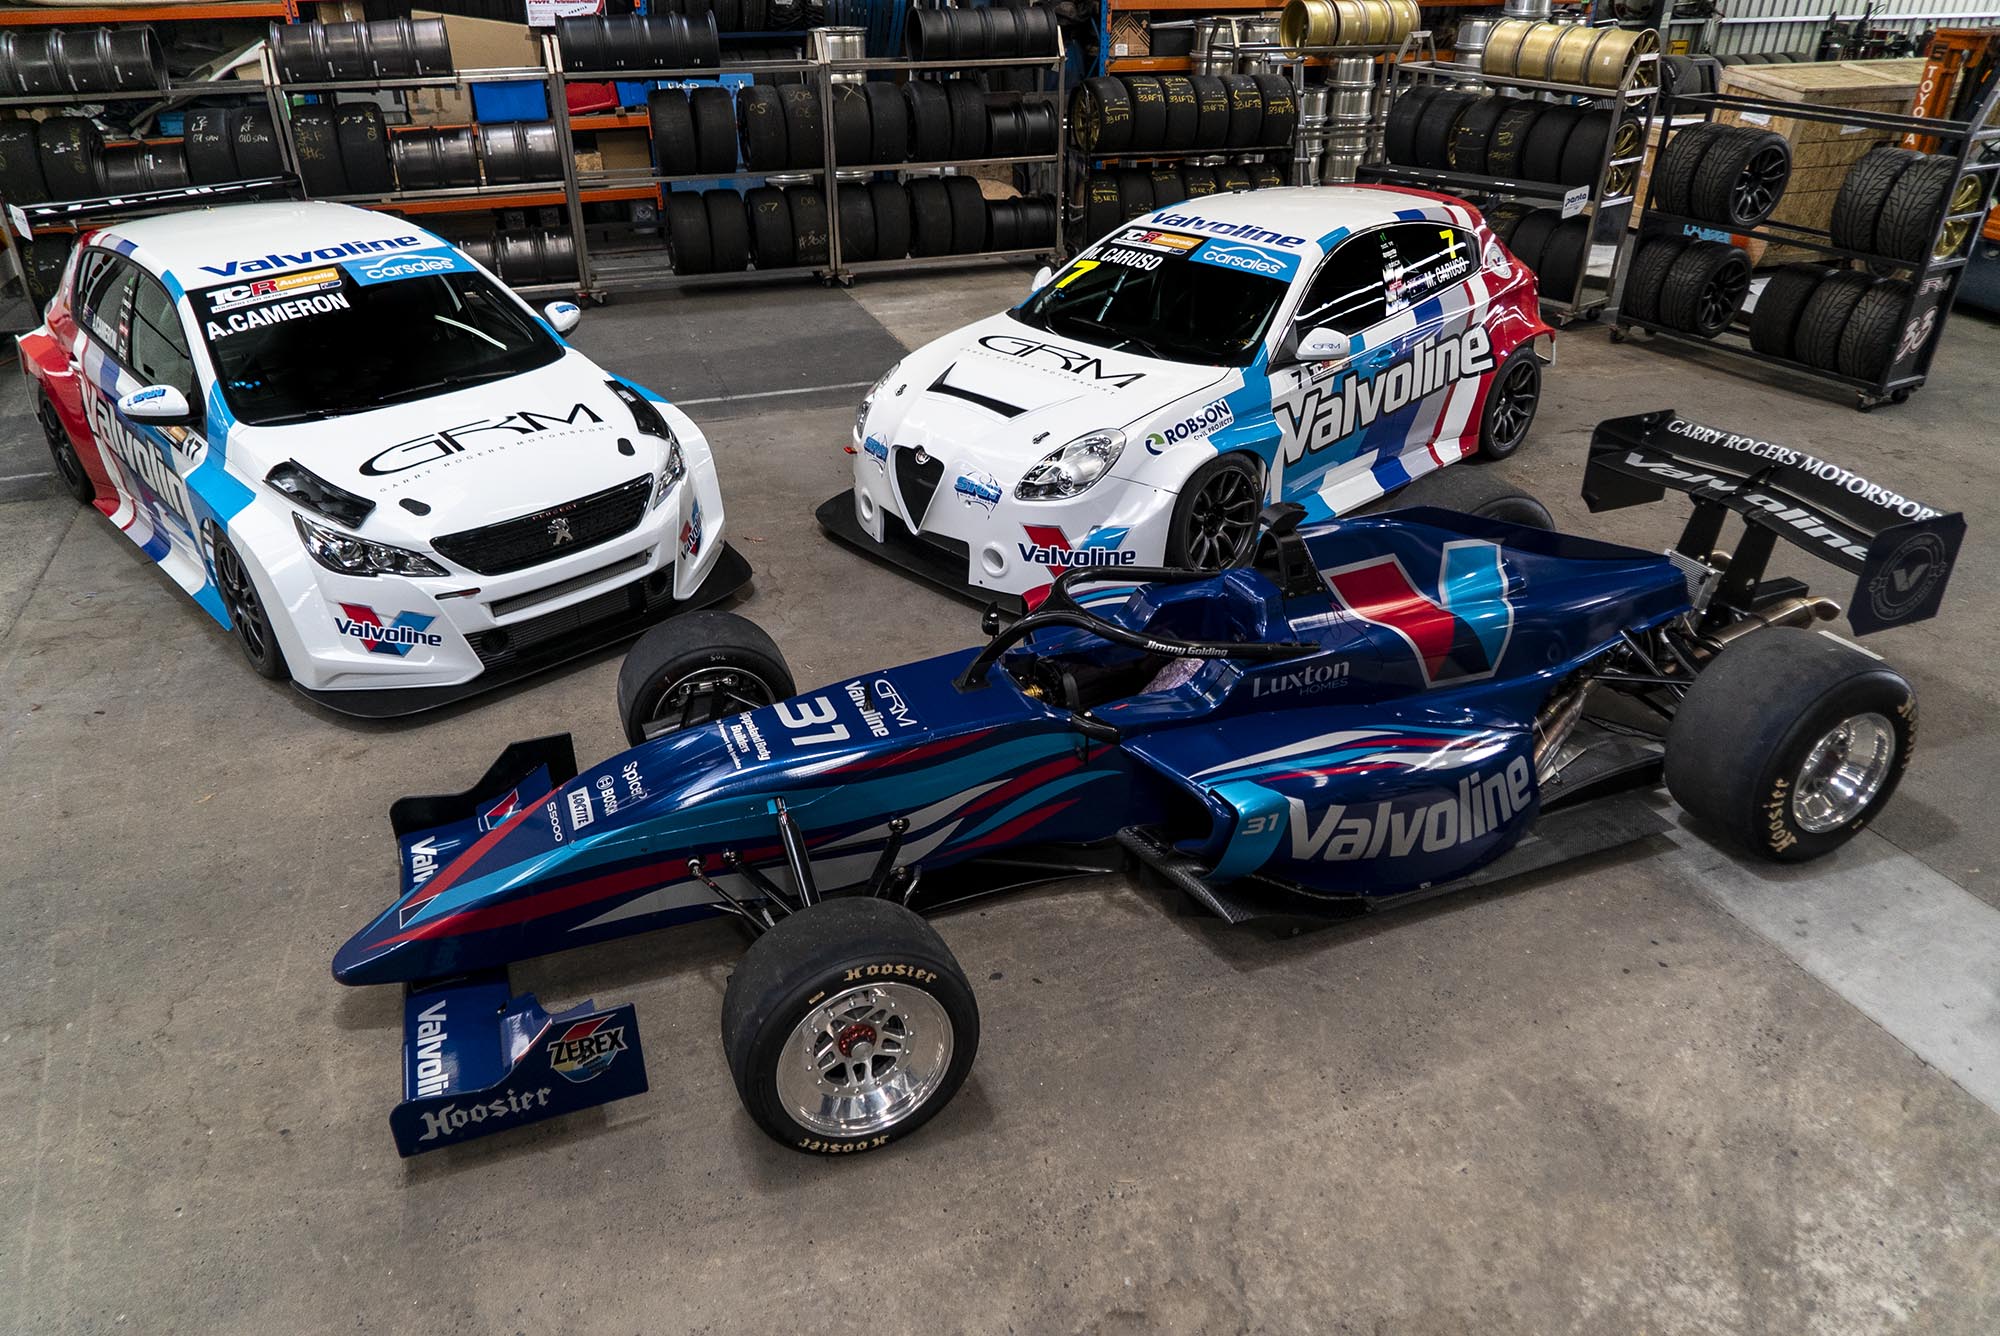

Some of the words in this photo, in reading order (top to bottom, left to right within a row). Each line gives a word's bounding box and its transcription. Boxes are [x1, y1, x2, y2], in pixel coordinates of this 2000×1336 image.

[1904, 65, 1939, 145] TOYOA
[1120, 228, 1163, 244] TCR
[1151, 211, 1307, 249] Valvoline
[1438, 228, 1457, 260] 7
[199, 233, 422, 278] Valvoline
[366, 256, 456, 281] carsales
[1082, 246, 1105, 261] M.
[1100, 247, 1164, 272] CARUSO
[1202, 250, 1282, 275] carsales
[279, 270, 336, 287] Australia
[1055, 260, 1102, 289] 7
[205, 279, 281, 307] TCR
[205, 292, 351, 341] A.CAMERON
[1311, 342, 1341, 350] GRM
[1894, 306, 1938, 364] 33
[978, 335, 1147, 389] GRM
[1272, 323, 1497, 466] Valvoline
[1290, 369, 1303, 390] 7
[1163, 400, 1231, 446] ROBSON
[1207, 416, 1234, 434] PROJECTS
[186, 436, 203, 461] 17
[358, 402, 605, 478] GRM
[1667, 419, 1729, 446] GARRY
[1723, 434, 1802, 466] ROGERS
[379, 468, 432, 493] GARRY
[444, 445, 506, 468] ROGERS
[515, 425, 614, 447] MOTORSPORT
[531, 502, 578, 521] PEUGEOT
[1016, 542, 1137, 567] Valvoline
[334, 616, 443, 647] Valvoline
[1143, 639, 1186, 656] Jimmy
[1186, 646, 1229, 657] Golding
[1252, 660, 1351, 699] Luxton
[1299, 678, 1350, 697] HOMES
[874, 678, 918, 728] GRM
[771, 695, 851, 747] 31
[729, 723, 751, 754] Builders
[546, 801, 563, 843] S5000
[571, 792, 590, 827] LOCTITE
[1287, 753, 1531, 862] Valvoline
[1762, 777, 1798, 854] Hoosier
[1240, 812, 1281, 836] 31
[842, 962, 938, 985] Hoosier
[547, 1027, 625, 1067] ZEREX
[417, 1085, 553, 1143] Hoosier
[798, 1133, 890, 1153] Hoosier
